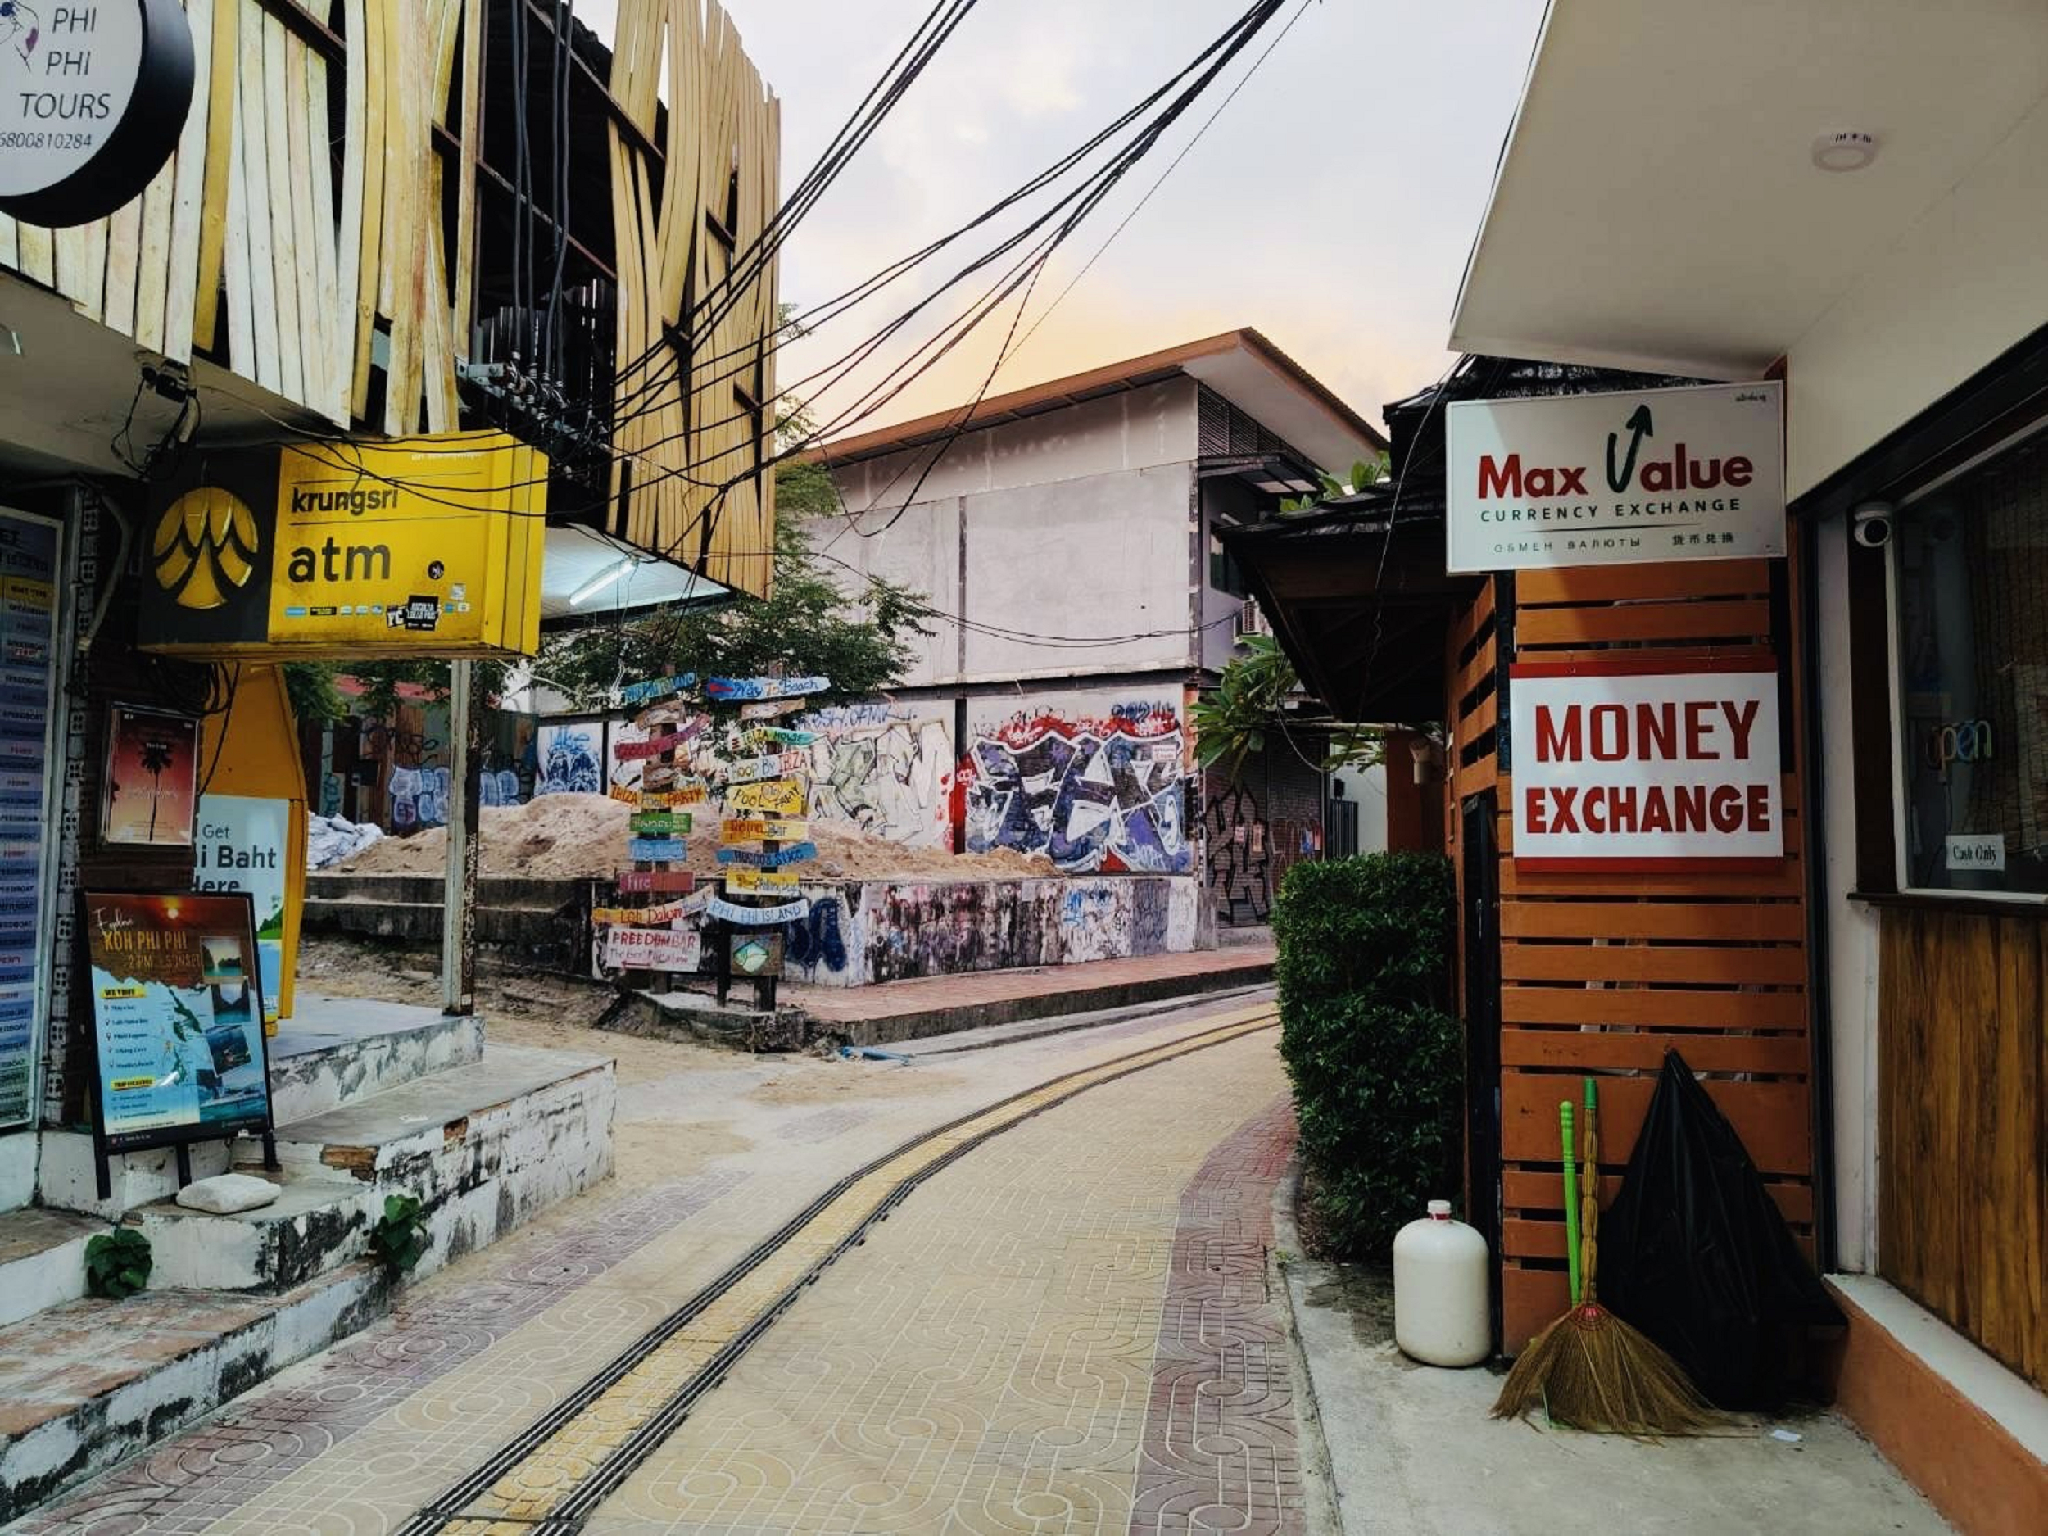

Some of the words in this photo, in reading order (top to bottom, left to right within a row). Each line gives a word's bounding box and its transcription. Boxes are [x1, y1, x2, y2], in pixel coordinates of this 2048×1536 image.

[52, 7, 97, 34] PHI
[46, 51, 91, 76] PHI
[20, 92, 111, 120] TOURS
[1478, 453, 1588, 500] Max
[291, 487, 398, 516] krungsri
[1481, 505, 1599, 522] CURRENCY
[1614, 498, 1742, 517] EXCHANGE
[1567, 538, 1641, 550] ВАЛЮТЫ
[288, 536, 391, 583] atm
[1535, 700, 1760, 763] MONEY
[1526, 785, 1770, 834] EXCHANGE
[202, 824, 231, 840] Get
[217, 844, 277, 869] Baht
[104, 931, 133, 951] KOH
[137, 931, 161, 950] PHI
[164, 931, 188, 950] PHI
